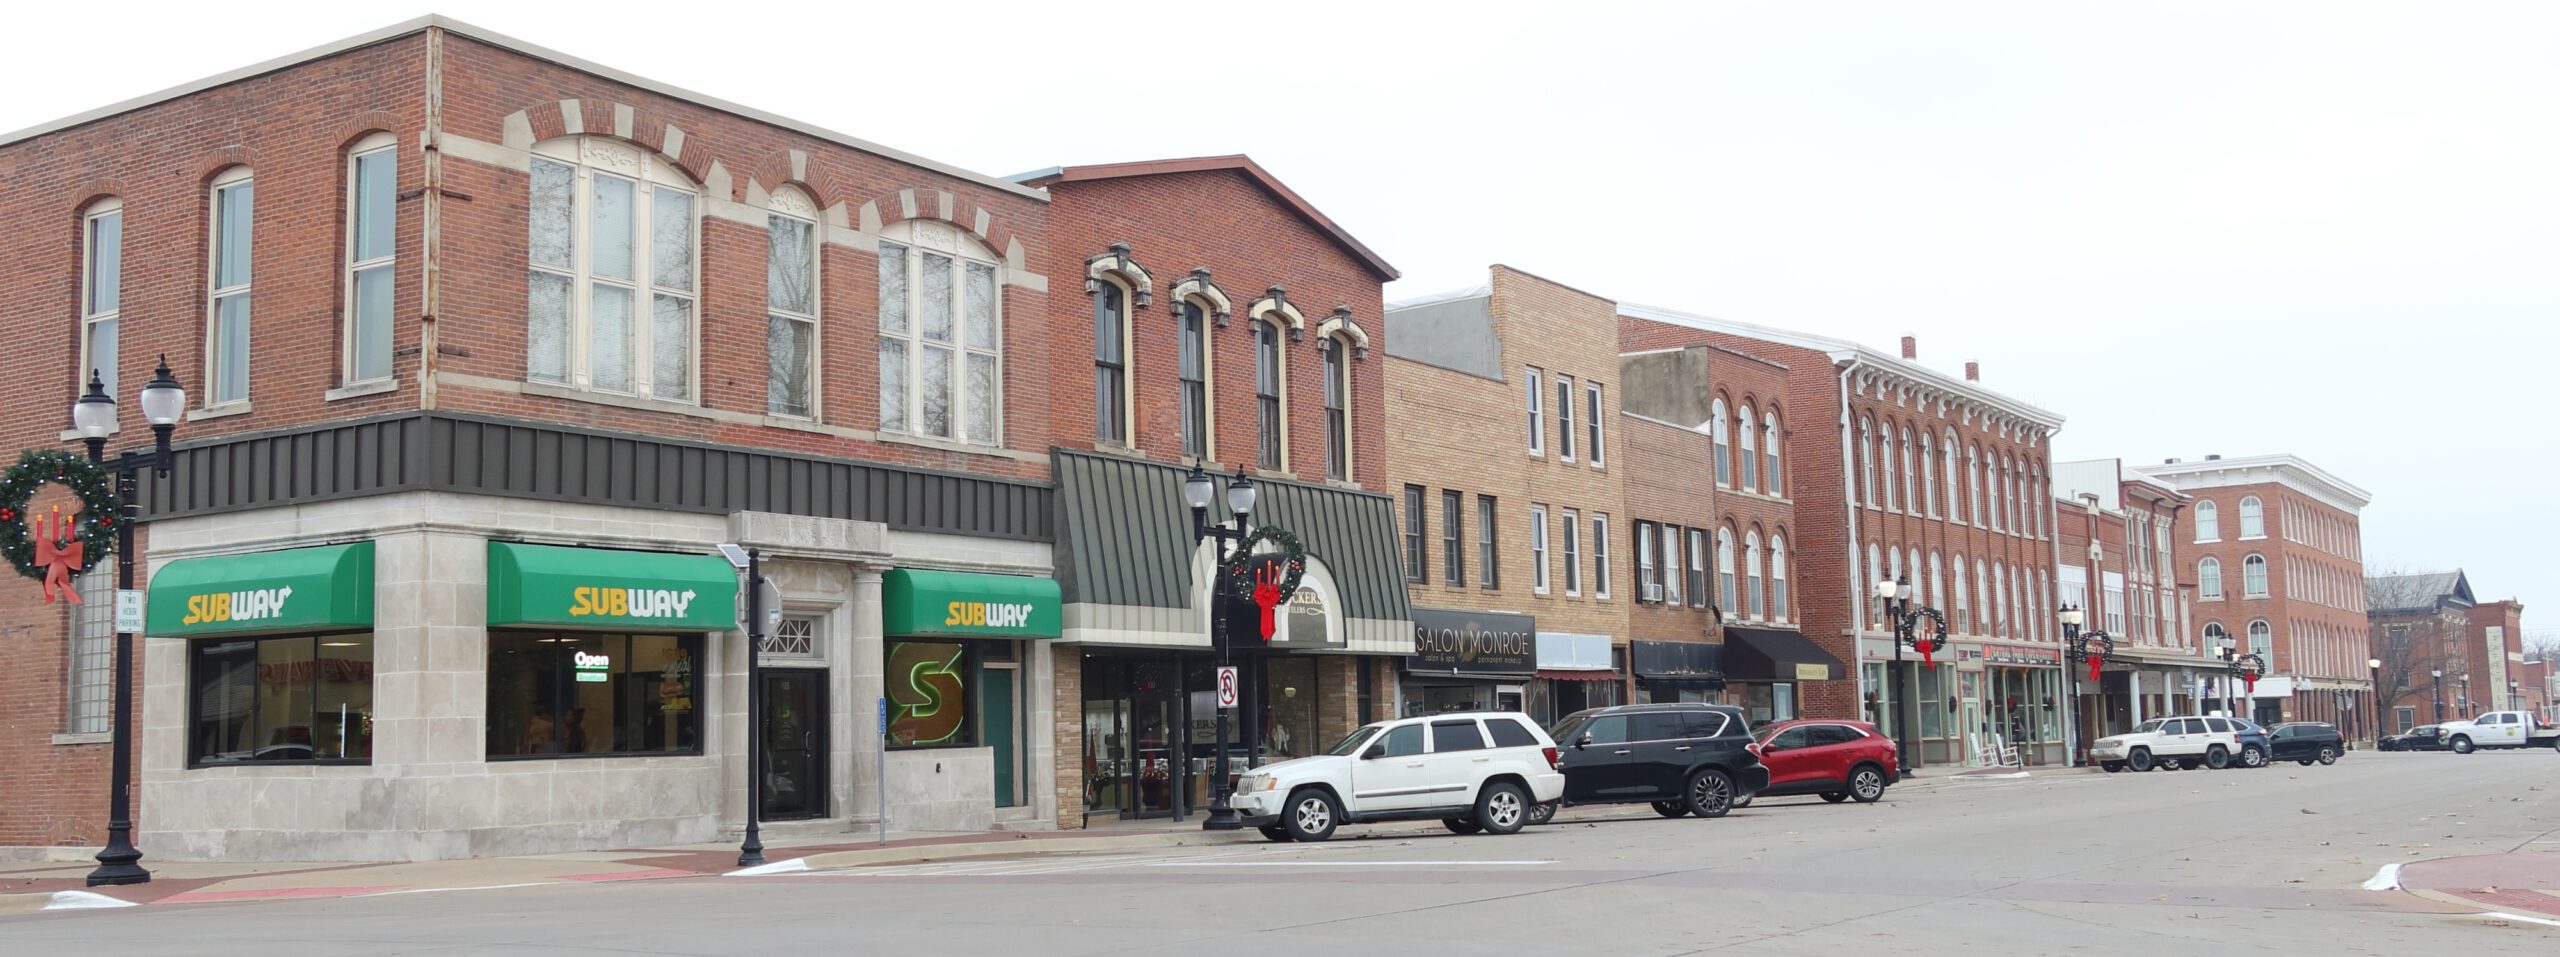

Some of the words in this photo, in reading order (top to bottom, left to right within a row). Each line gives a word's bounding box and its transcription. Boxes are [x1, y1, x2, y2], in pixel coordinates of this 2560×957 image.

[125, 596, 136, 604] TWO
[183, 585, 293, 626] SUBWAY
[569, 586, 696, 618] SUBWAY
[119, 619, 141, 627] PARKING
[123, 608, 137, 616] HOUR
[945, 601, 1033, 627] SUBWAY
[1416, 626, 1464, 653] SALON
[1470, 630, 1529, 655] MONROE
[574, 651, 609, 669] Open
